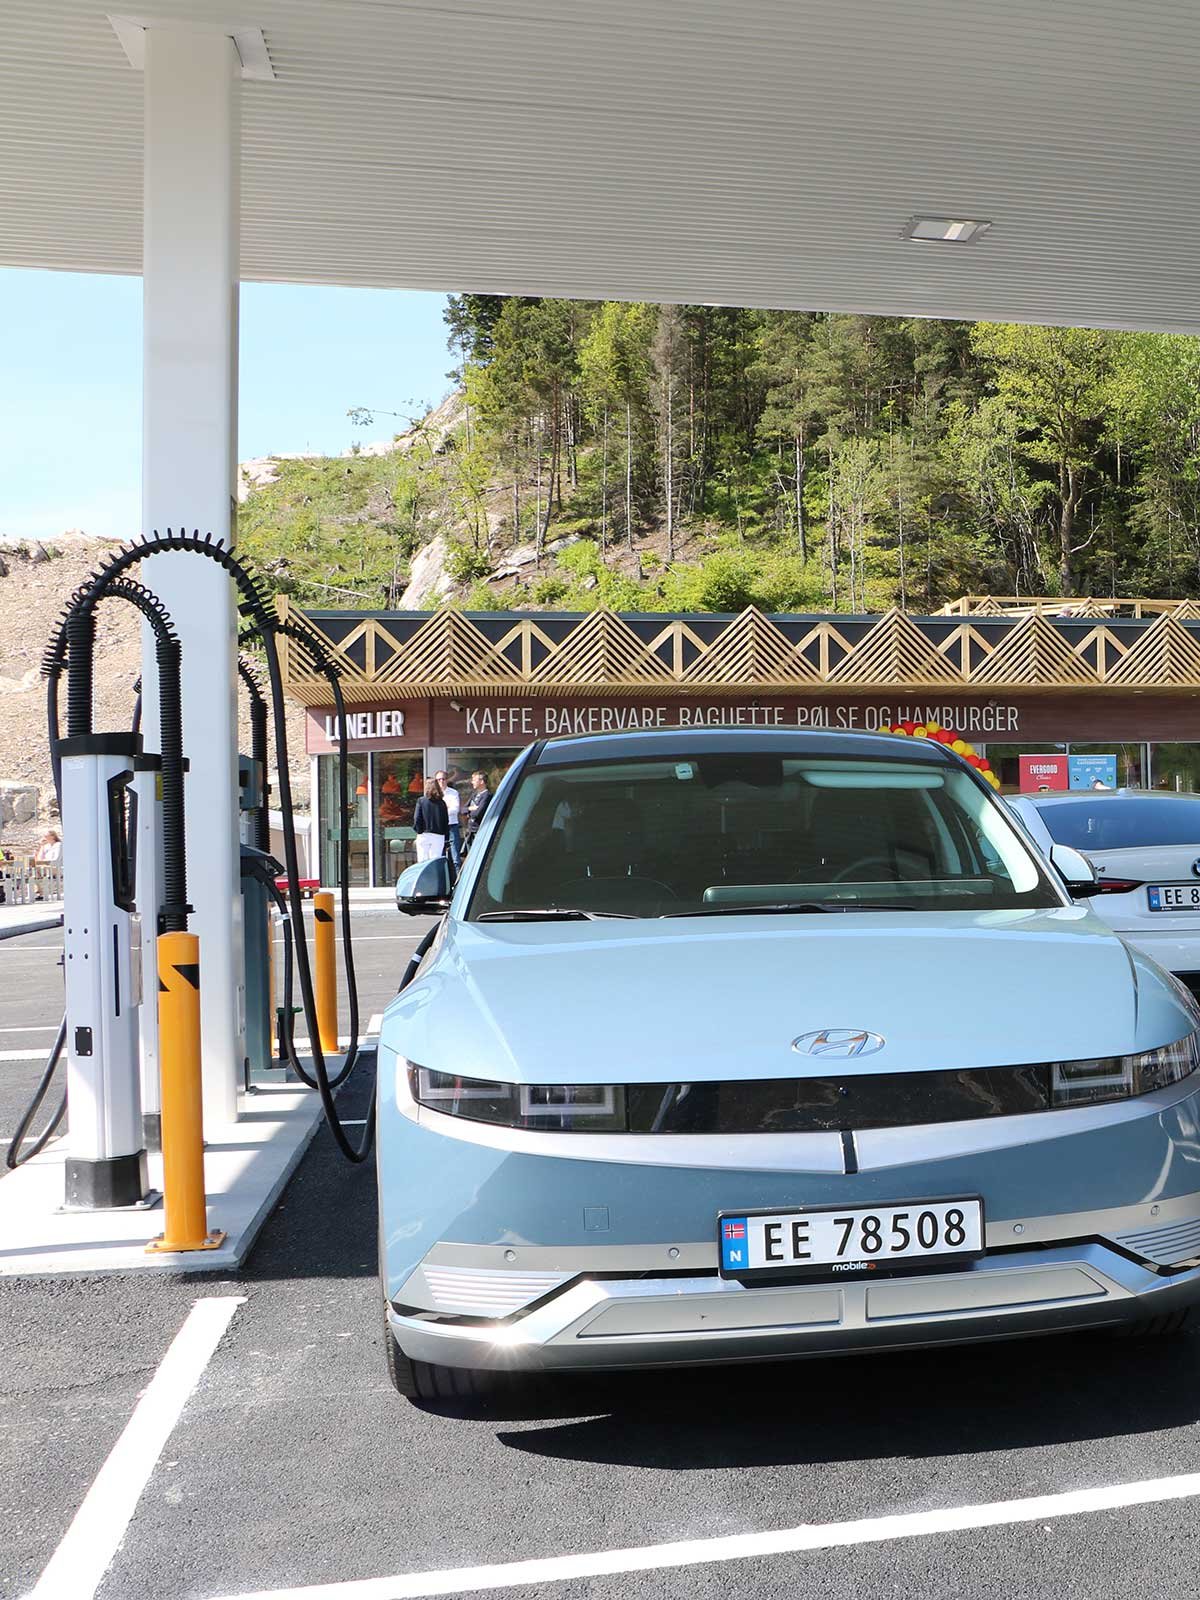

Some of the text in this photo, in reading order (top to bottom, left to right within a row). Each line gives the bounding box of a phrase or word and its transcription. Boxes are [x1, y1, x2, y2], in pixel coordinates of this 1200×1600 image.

[466, 707, 539, 737] KAFFE,
[545, 706, 667, 734] BAKERVARE
[679, 706, 784, 726] BAGUETTE
[865, 706, 892, 731] OG
[897, 706, 1019, 732] HAMBURGER
[1164, 888, 1184, 905] EE
[763, 1208, 967, 1261] EE 78508
[729, 1251, 742, 1262] N
